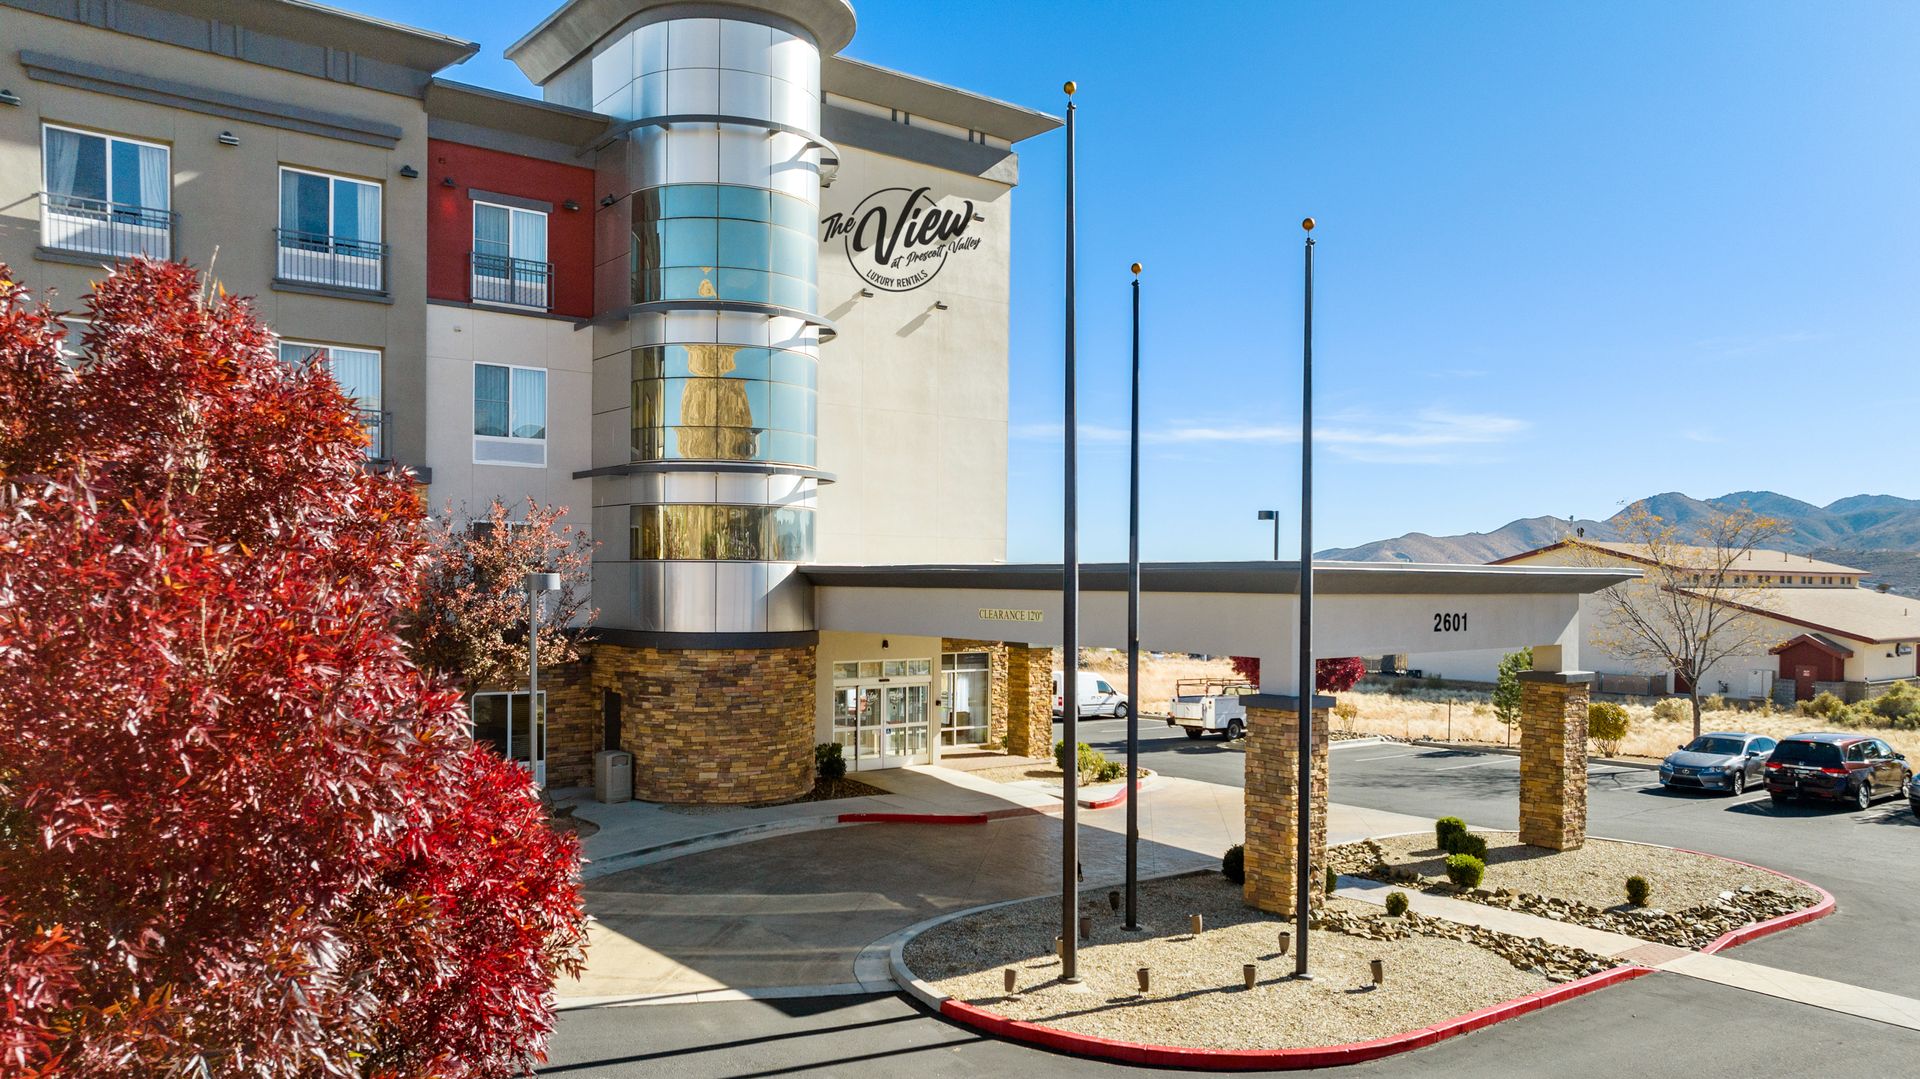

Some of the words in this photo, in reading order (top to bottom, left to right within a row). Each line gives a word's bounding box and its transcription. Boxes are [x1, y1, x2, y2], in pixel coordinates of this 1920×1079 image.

[821, 212, 856, 242] The
[852, 187, 974, 265] View
[890, 256, 905, 269] at
[905, 244, 946, 267] Prescott
[948, 235, 981, 254] Valley
[866, 269, 895, 287] LUXURY
[896, 269, 928, 288] RENTALS
[979, 608, 1026, 621] CLEARANCE
[1433, 612, 1468, 632] 2601
